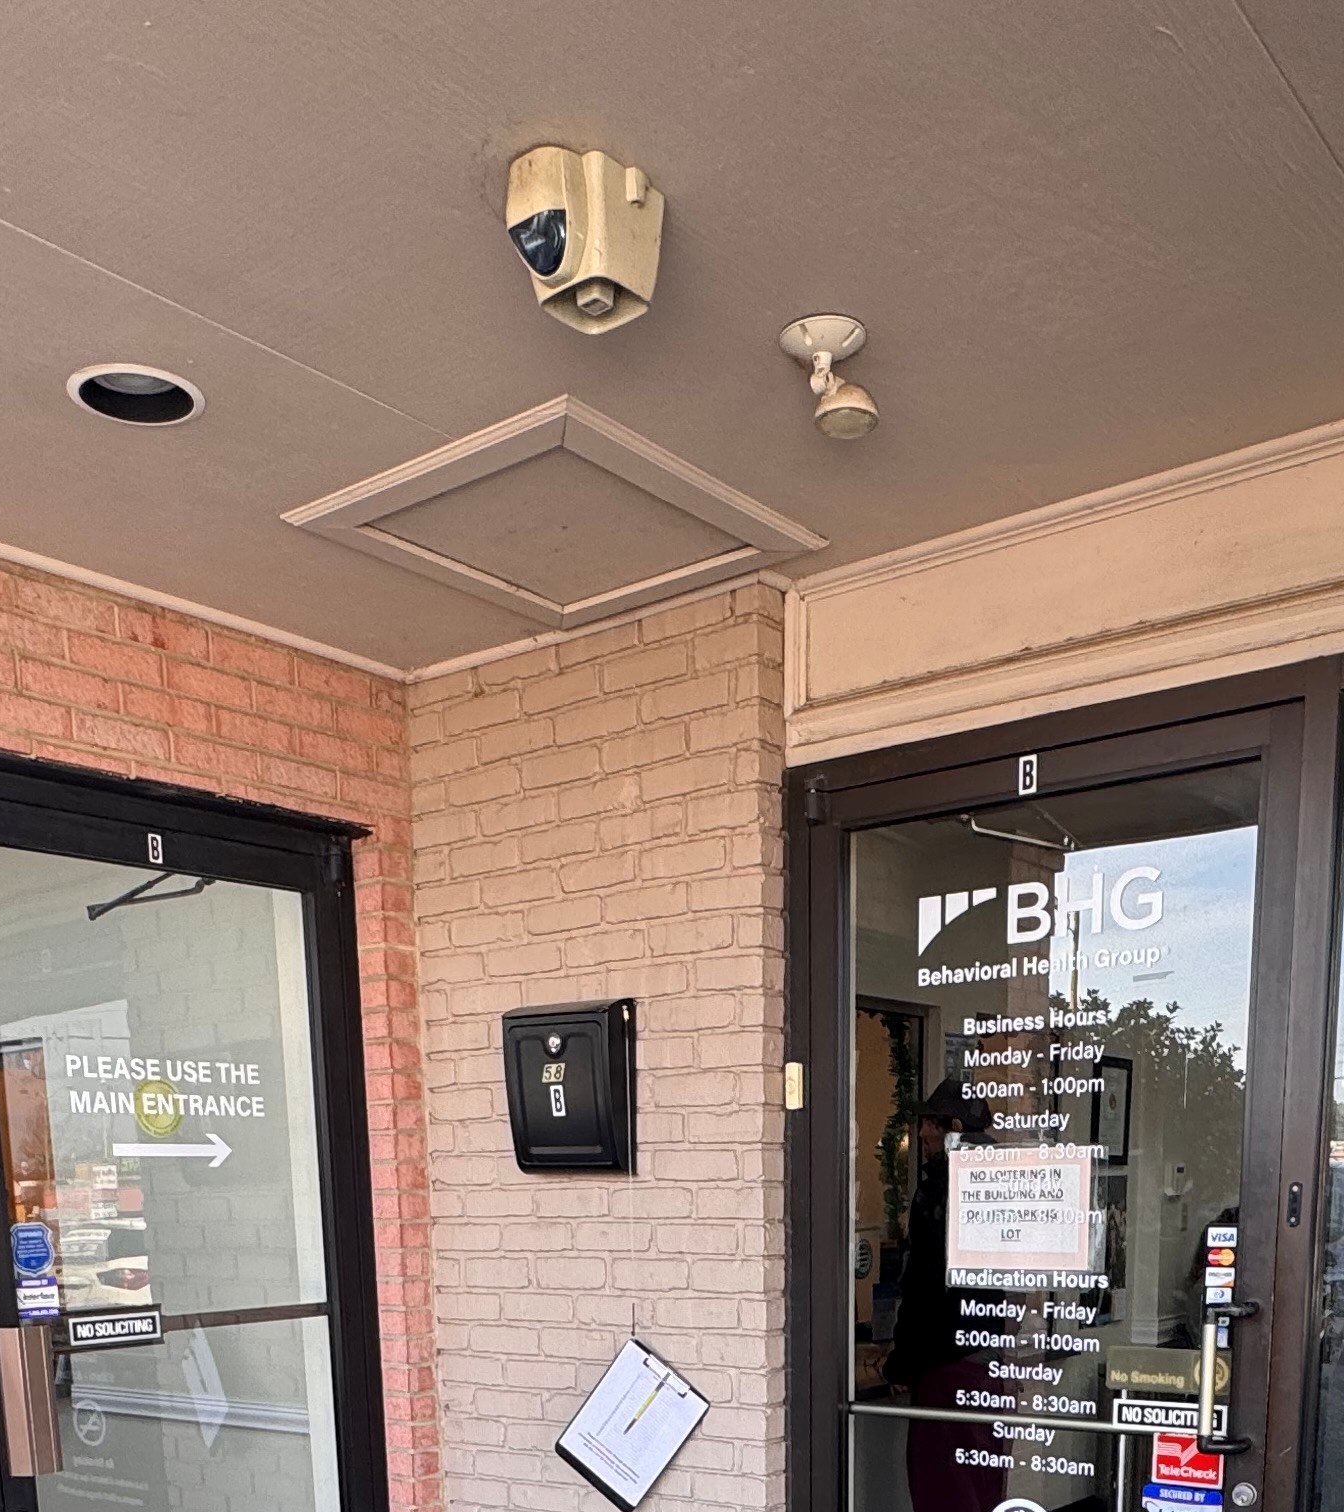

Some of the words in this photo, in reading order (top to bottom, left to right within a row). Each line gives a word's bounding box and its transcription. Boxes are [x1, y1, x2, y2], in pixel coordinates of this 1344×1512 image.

[1022, 760, 1034, 791] B
[1007, 866, 1163, 944] BHG
[918, 957, 1017, 987] Behavioral
[1023, 953, 1088, 976] Health
[964, 1015, 1044, 1036] Business
[1050, 1010, 1106, 1029] Hours
[964, 1046, 1032, 1068] Monday
[1050, 1041, 1104, 1063] Friday
[65, 1055, 161, 1080] PLEASE
[166, 1060, 212, 1083] USE
[215, 1062, 261, 1085] THE
[544, 1065, 563, 1080] 58
[962, 1081, 1023, 1100] 5:00am
[1042, 1076, 1104, 1097] 1:00pm
[69, 1090, 135, 1114] MAIN
[142, 1093, 265, 1117] ENTRANCE
[553, 1088, 563, 1113] B
[993, 1110, 1070, 1131] Saturday
[970, 1170, 985, 1182] NO
[1050, 1168, 1061, 1179] IN
[962, 1190, 981, 1201] THE
[985, 1189, 1036, 1201] BUILDING
[1039, 1188, 1064, 1200] AND
[1001, 1228, 1021, 1240] LOT
[1211, 1232, 1235, 1242] VISA
[951, 1269, 1047, 1287] Medication
[1053, 1271, 1109, 1288] Hours
[960, 1299, 1026, 1322] Monday
[1043, 1301, 1097, 1324] Friday
[76, 1323, 94, 1338] NO
[95, 1319, 153, 1337] SOLICITING
[955, 1330, 1015, 1349] 5:00am
[1033, 1333, 1100, 1352] 11:00am
[988, 1361, 1063, 1385] Saturday
[1110, 1369, 1129, 1383] No
[1131, 1370, 1185, 1388] Smoking
[956, 1390, 1015, 1409] 5:30am
[1032, 1394, 1096, 1415] 8:30am
[1122, 1406, 1142, 1423] NO
[1143, 1407, 1218, 1430] SOLICITIG
[993, 1421, 1055, 1446] Sunday
[955, 1448, 1014, 1469] 5:30am
[1031, 1455, 1095, 1476] 8:30am
[1158, 1464, 1217, 1480] TeleCheck
[1159, 1488, 1193, 1500] SECURED
[1194, 1492, 1206, 1502] BY
